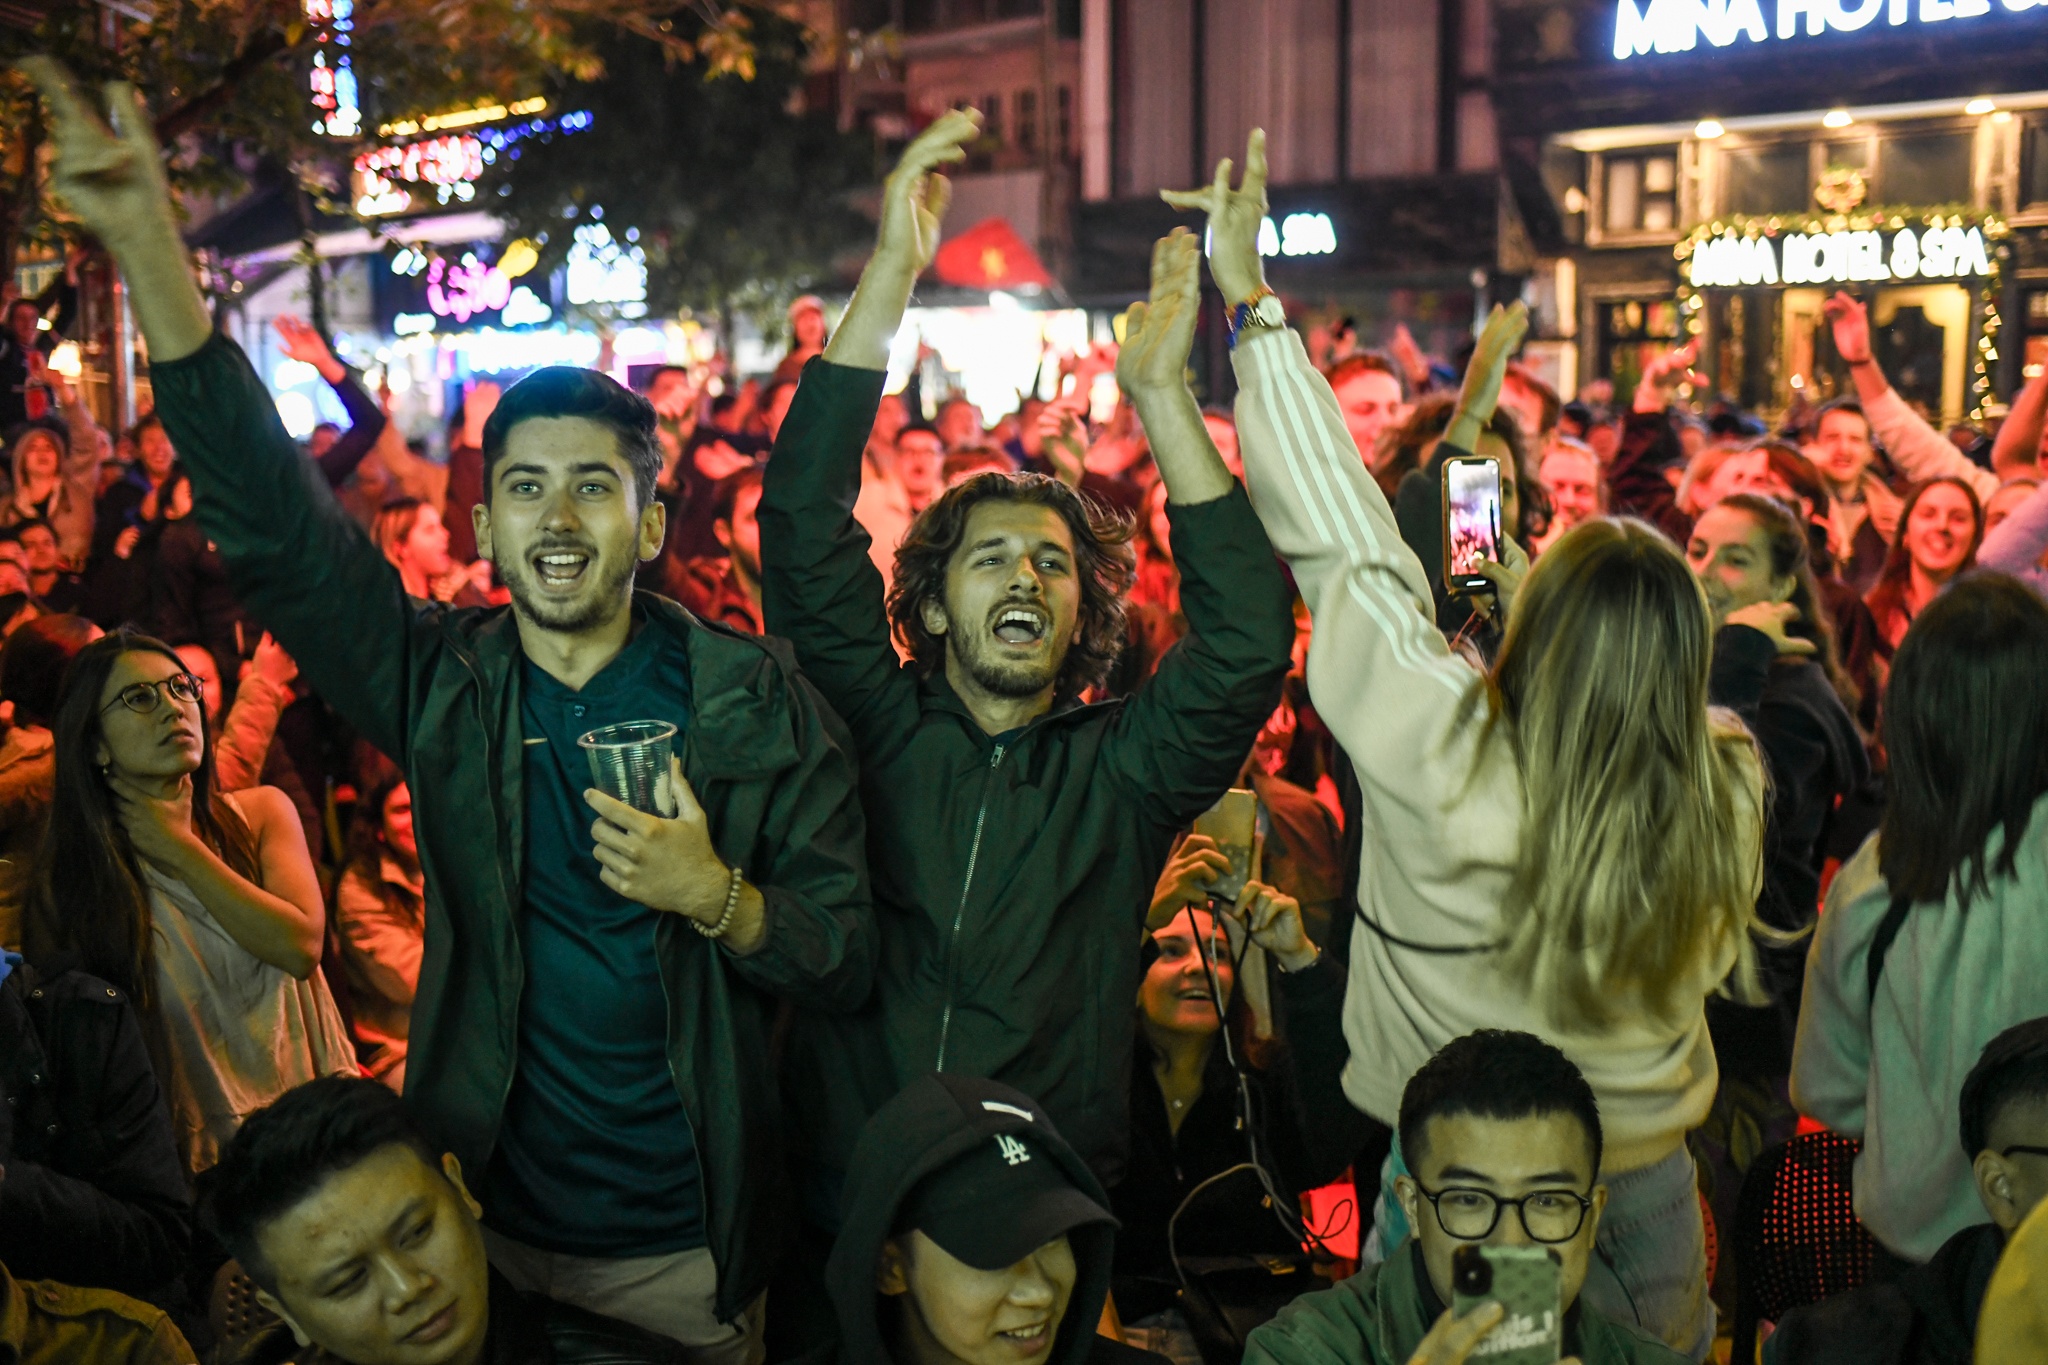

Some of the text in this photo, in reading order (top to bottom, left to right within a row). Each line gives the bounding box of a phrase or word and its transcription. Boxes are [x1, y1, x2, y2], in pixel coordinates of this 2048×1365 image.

[1782, 230, 1891, 284] HOTEL
[1890, 228, 1920, 279] &
[1919, 226, 1989, 277] SPA
[994, 1133, 1031, 1166] LA
